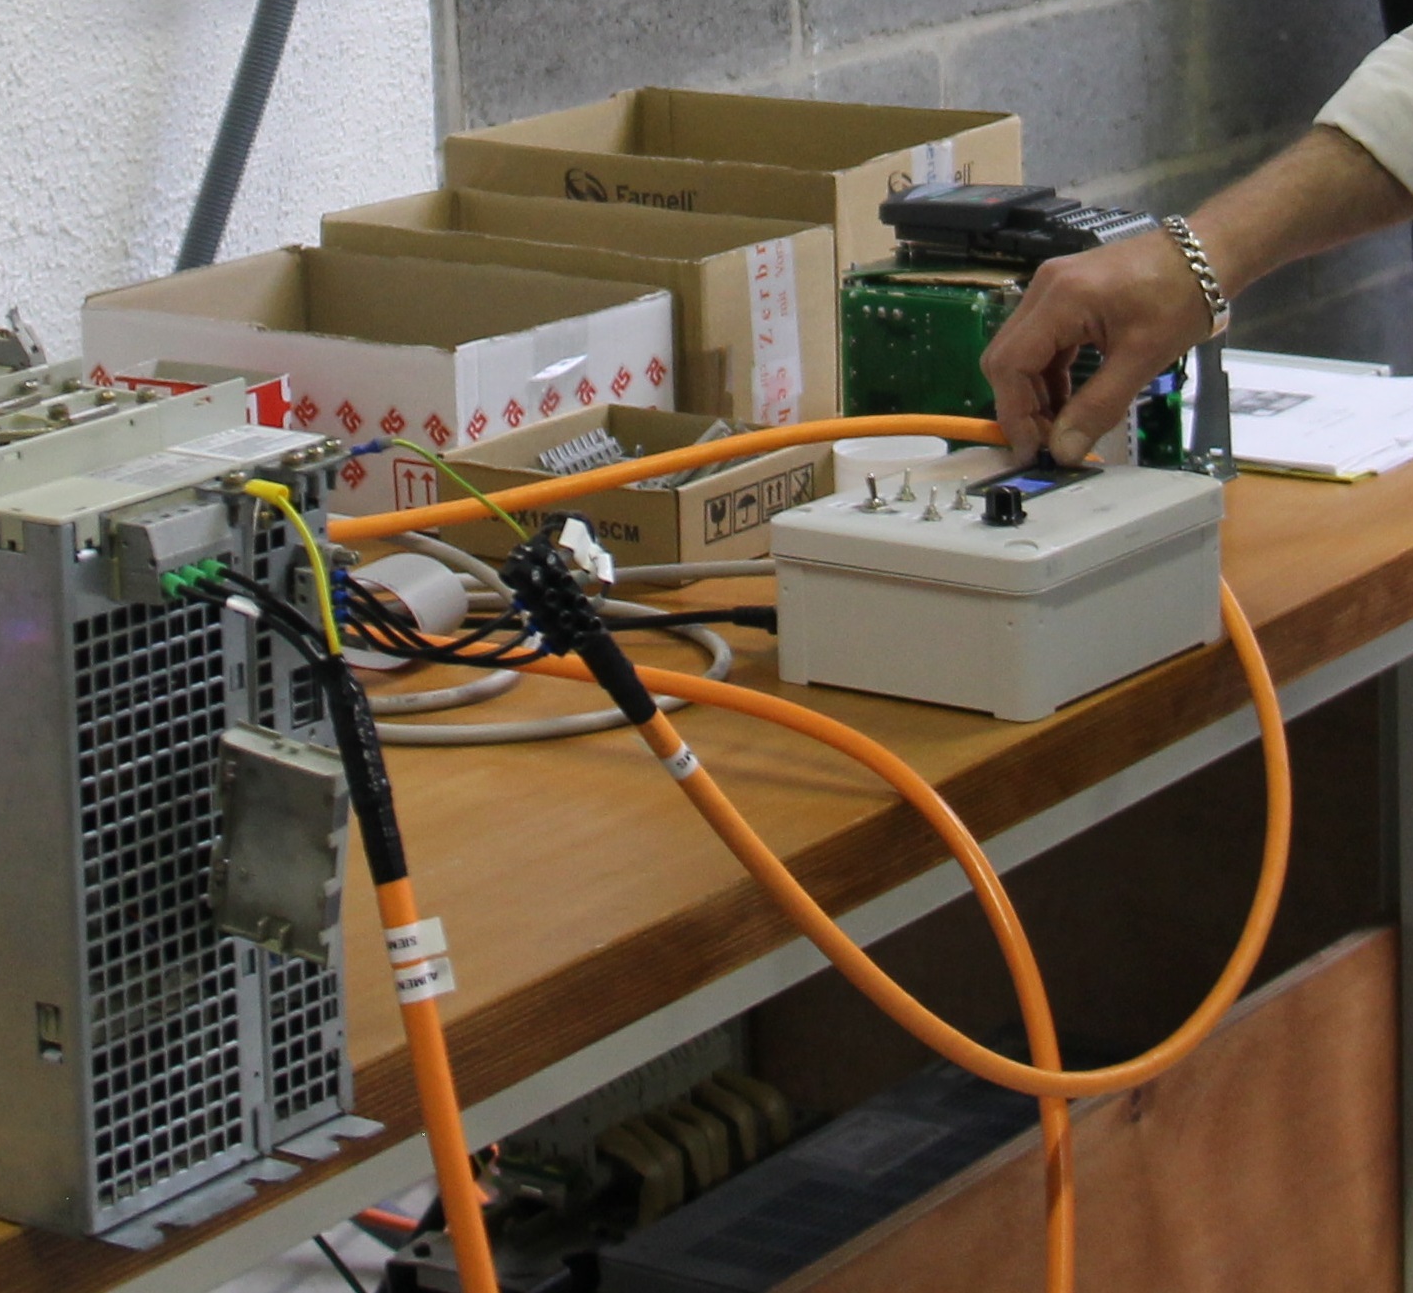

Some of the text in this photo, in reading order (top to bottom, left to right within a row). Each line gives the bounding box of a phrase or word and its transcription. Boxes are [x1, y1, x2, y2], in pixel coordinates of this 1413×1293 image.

[615, 184, 693, 211] Farnell
[611, 366, 632, 398] RS
[294, 394, 320, 428] RS
[336, 399, 363, 435] RS
[539, 386, 562, 418] RS
[380, 407, 406, 436] RS
[424, 413, 452, 447] RS
[466, 409, 488, 442] RS
